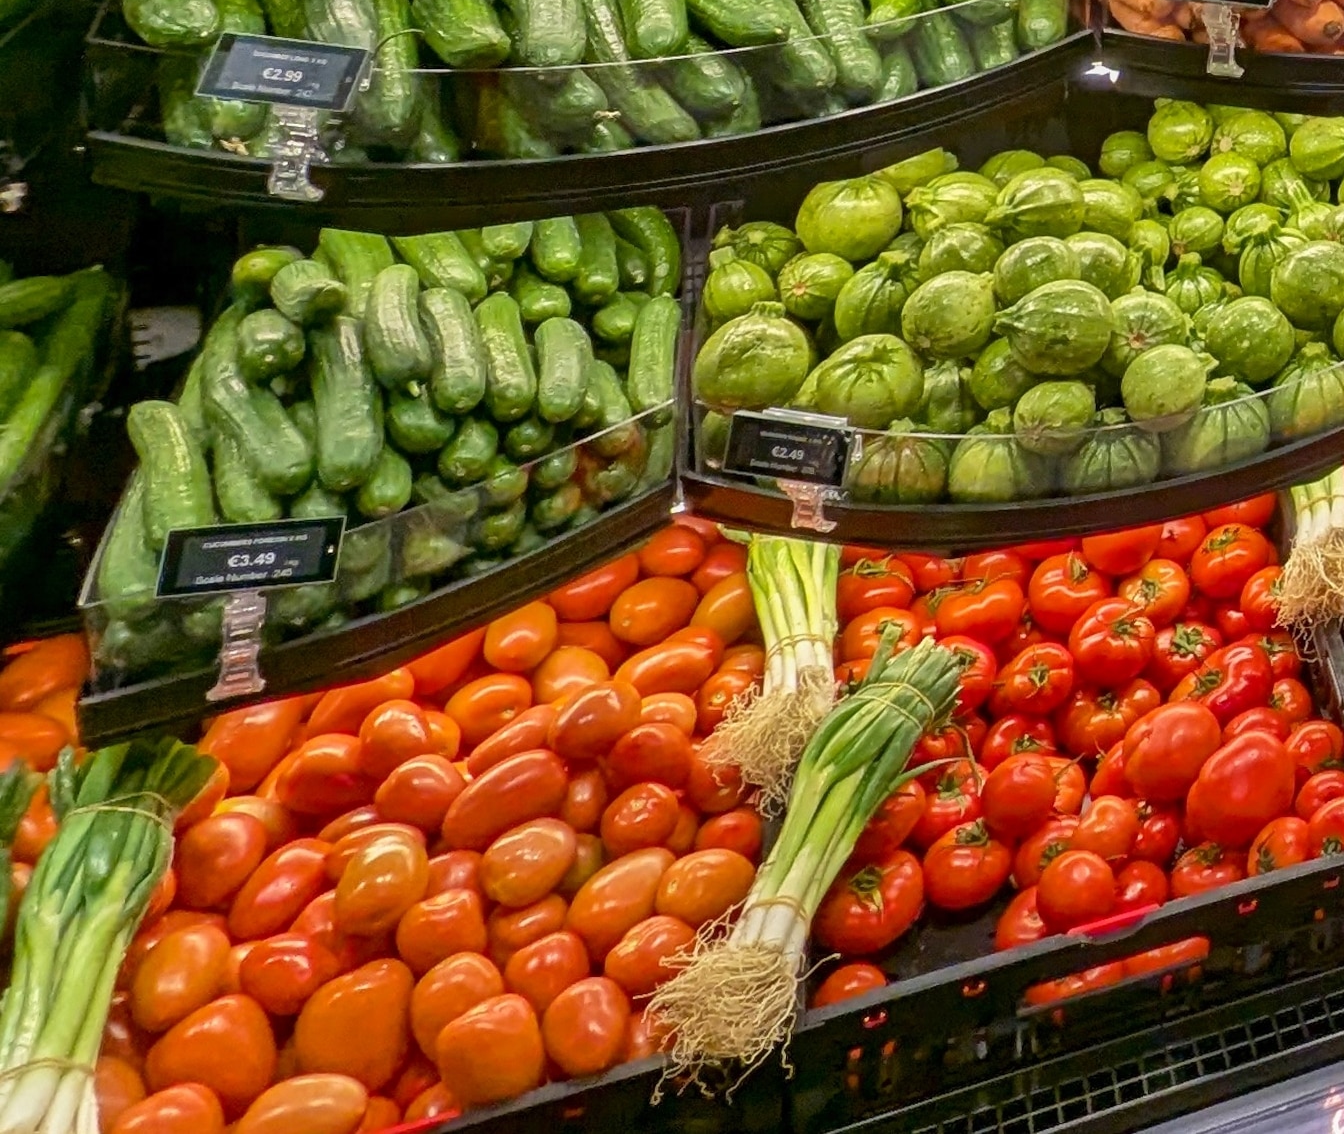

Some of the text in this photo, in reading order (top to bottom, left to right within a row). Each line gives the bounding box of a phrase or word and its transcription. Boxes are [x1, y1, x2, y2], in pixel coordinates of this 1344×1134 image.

[263, 67, 304, 83] €2.99
[772, 446, 805, 460] €2.49
[229, 552, 277, 568] €3.49
